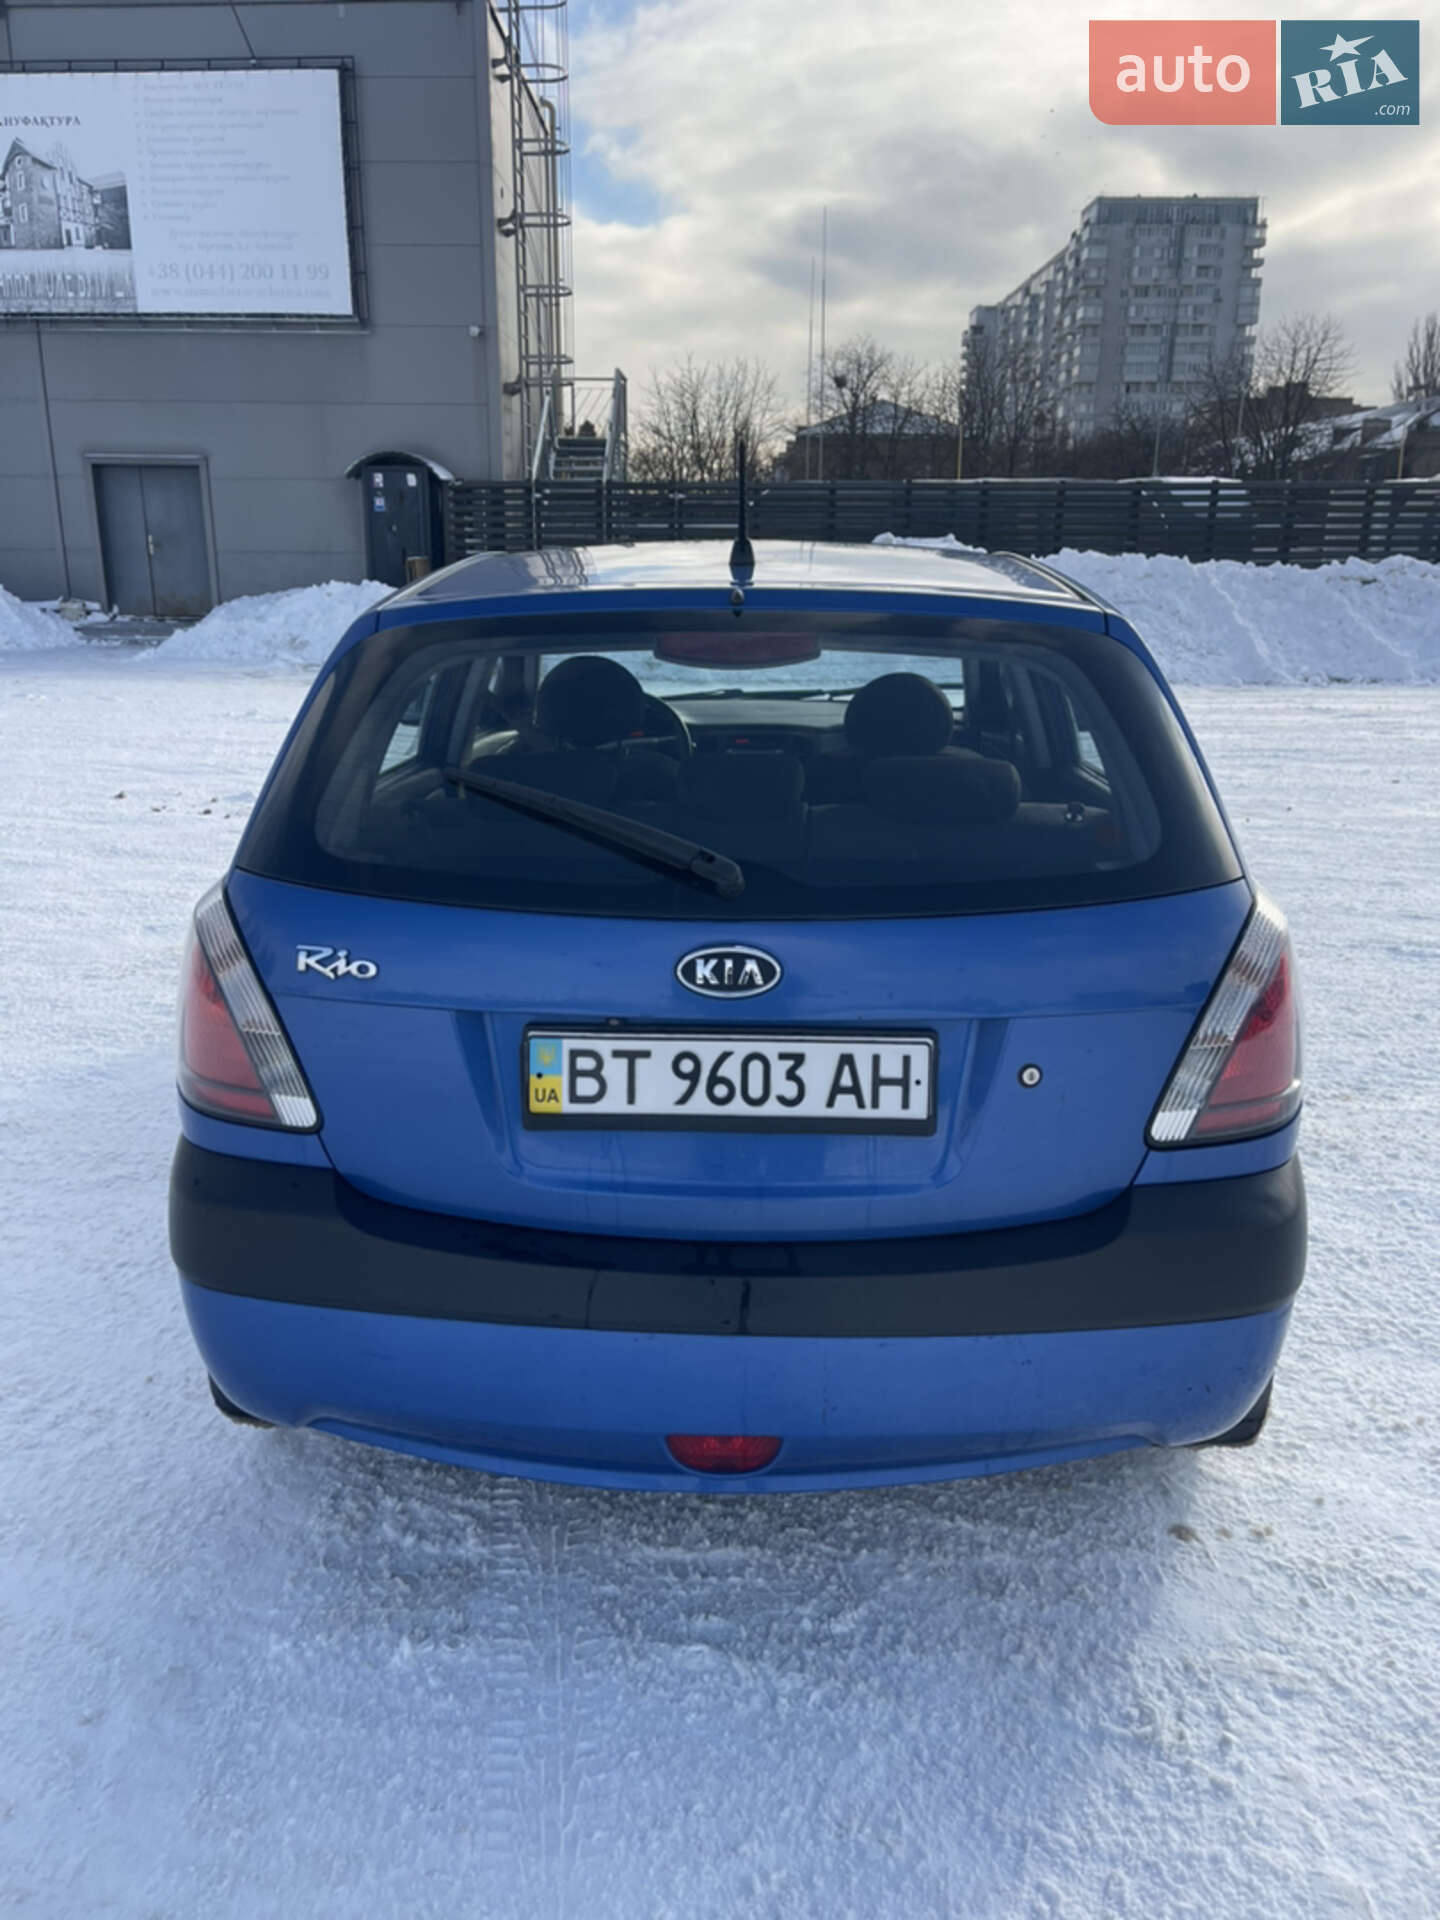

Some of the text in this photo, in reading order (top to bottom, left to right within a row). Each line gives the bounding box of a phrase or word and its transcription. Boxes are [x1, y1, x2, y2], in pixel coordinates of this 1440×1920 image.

[0, 115, 81, 128] НУФАКТУРА
[239, 262, 274, 280] 200
[296, 944, 378, 980] Rio
[695, 957, 764, 985] KIA
[567, 1049, 911, 1110] BT 9603 AH
[534, 1087, 559, 1104] UA
